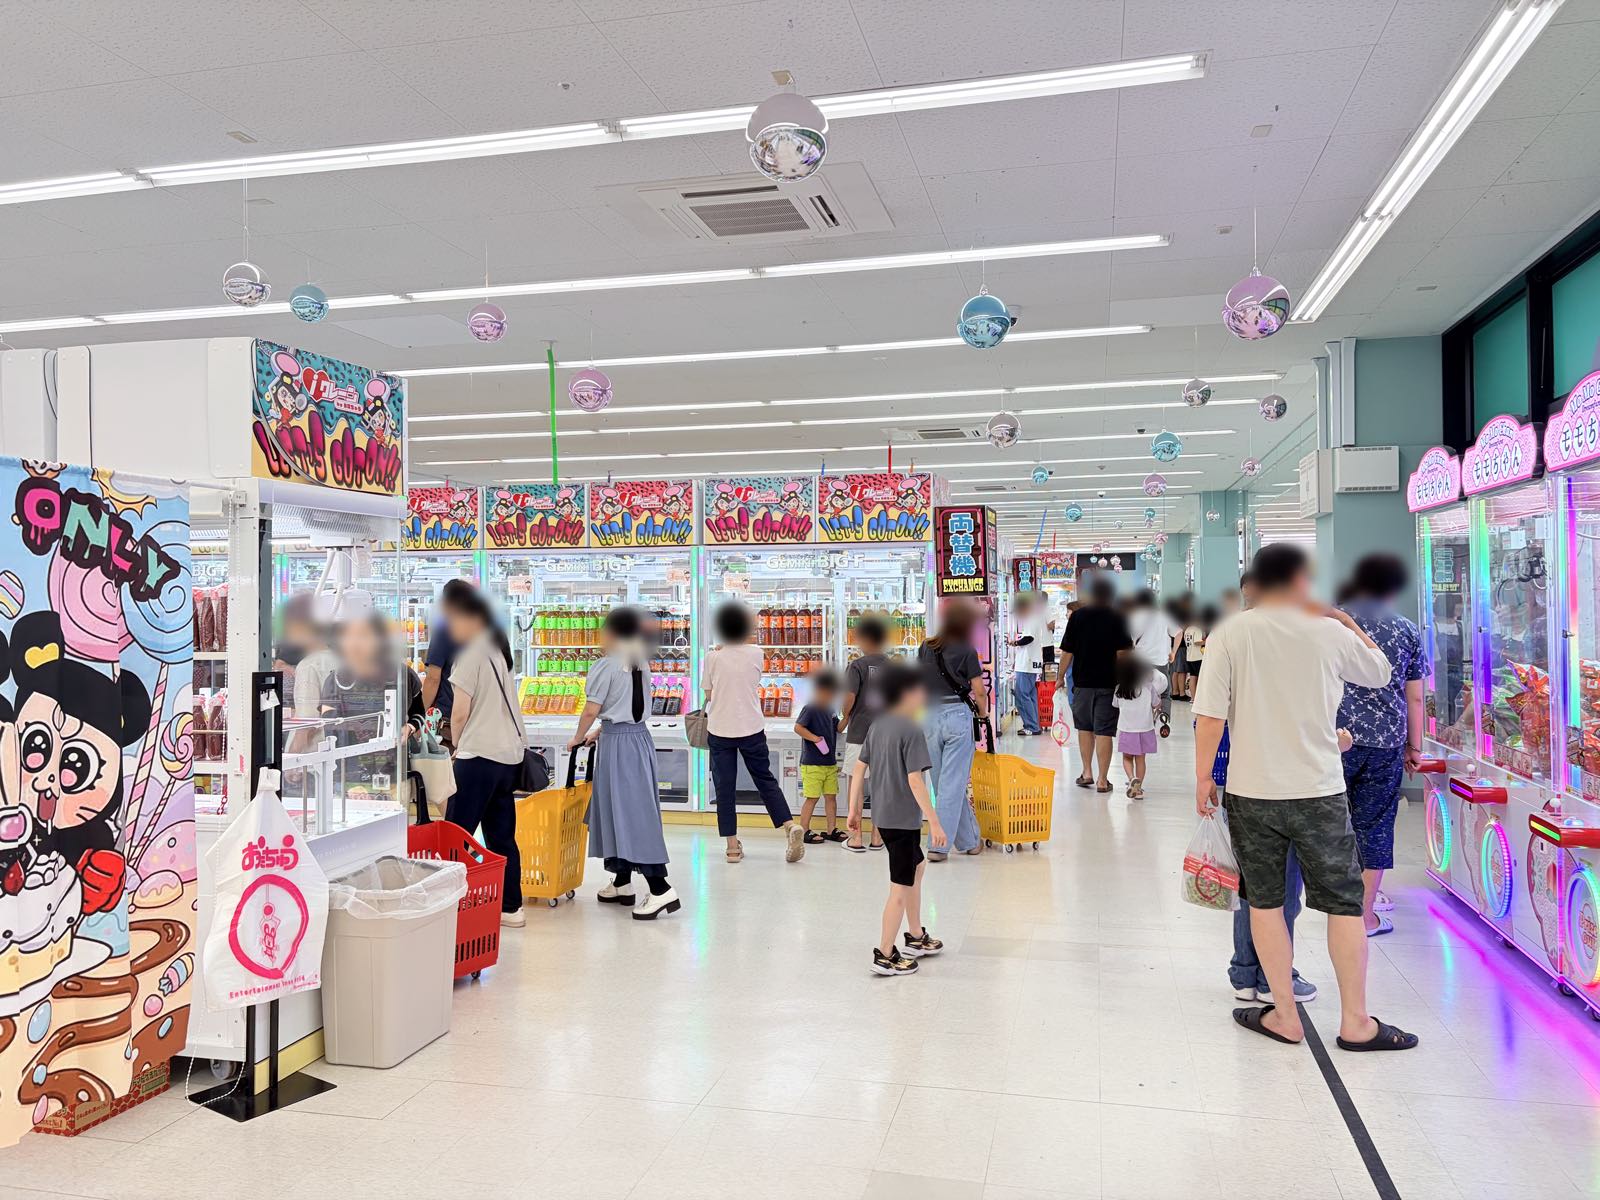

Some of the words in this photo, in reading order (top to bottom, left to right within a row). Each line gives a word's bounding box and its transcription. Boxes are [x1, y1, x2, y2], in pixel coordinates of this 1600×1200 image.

[1474, 446, 1519, 480] モモちゃん
[18, 480, 179, 600] ONLY
[486, 513, 526, 546] LET'S
[591, 511, 632, 546] LET'S
[705, 506, 749, 542] LET'S
[819, 505, 863, 540] LET'S
[949, 513, 977, 576] 両替機
[943, 578, 984, 593] EXCHANGE
